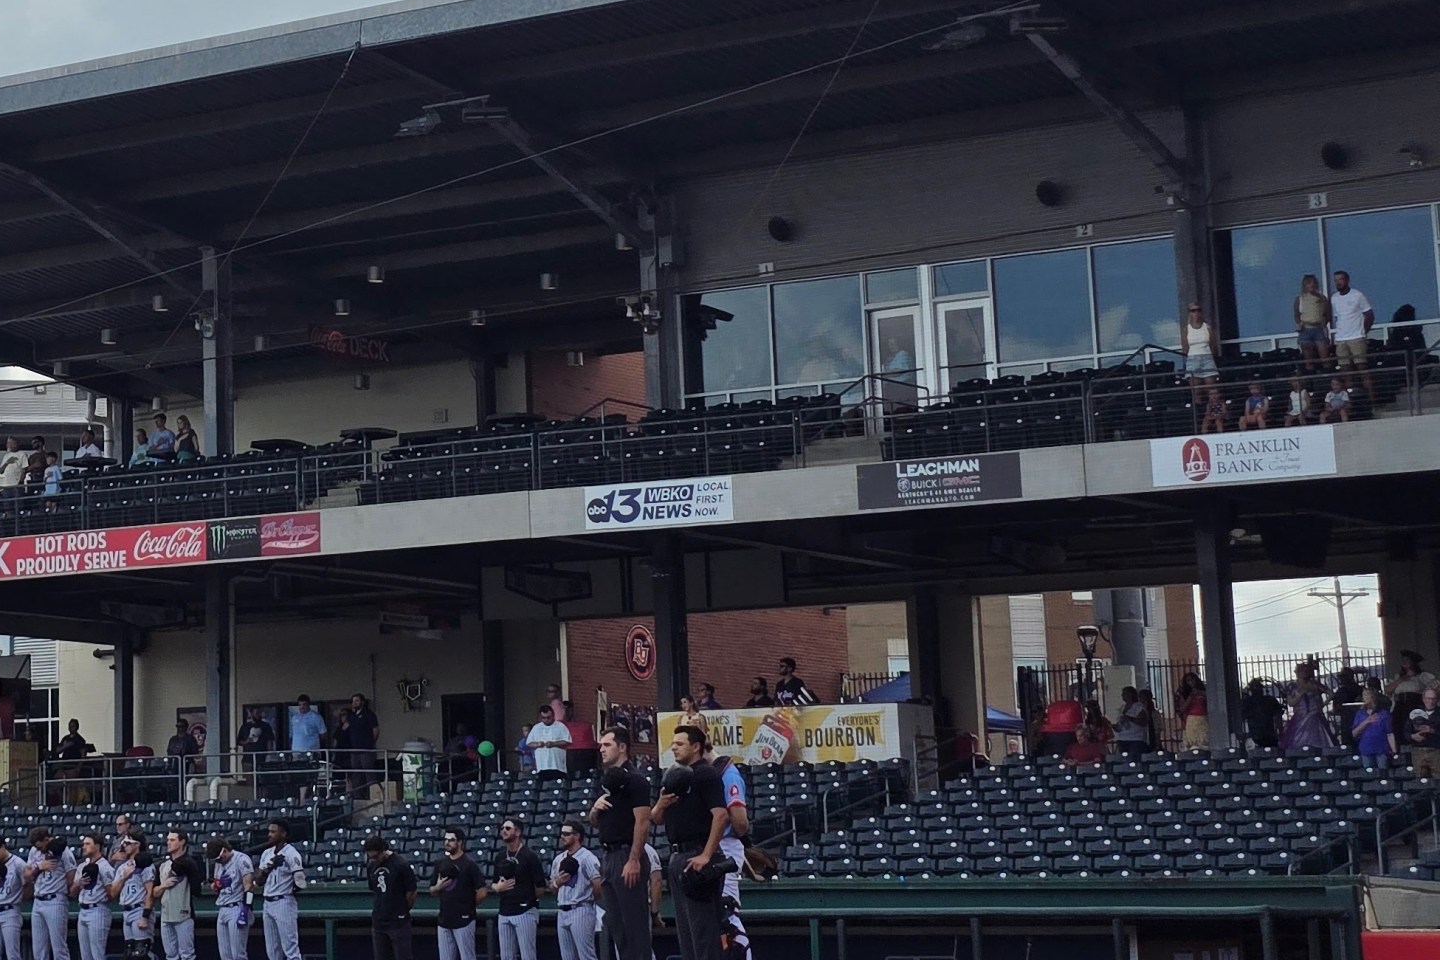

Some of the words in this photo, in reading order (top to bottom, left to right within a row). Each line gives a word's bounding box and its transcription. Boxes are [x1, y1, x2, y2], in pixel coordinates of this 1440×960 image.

[1314, 194, 1322, 207] 3
[1081, 224, 1088, 236] 2
[350, 337, 389, 362] DECK
[1215, 437, 1301, 457] FRANKLIN
[896, 458, 980, 478] LEACHMAN
[1216, 458, 1264, 474] BANK
[911, 479, 937, 489] BUICK
[647, 486, 691, 502] WBKO
[588, 505, 607, 515] abc
[604, 488, 642, 523] 13
[642, 503, 692, 520] NEWS
[694, 507, 719, 517] NOW.
[226, 527, 258, 537] MONSTER
[34, 536, 64, 555] HOT
[67, 531, 107, 551] RODS
[133, 526, 206, 561] Coca-Cola
[16, 553, 81, 576] PROUDLY
[84, 550, 127, 570] SERVE
[837, 715, 880, 726] EVERYONE'S
[755, 732, 769, 744] JIM
[768, 736, 784, 759] BEAM
[804, 726, 876, 748] BOURBON
